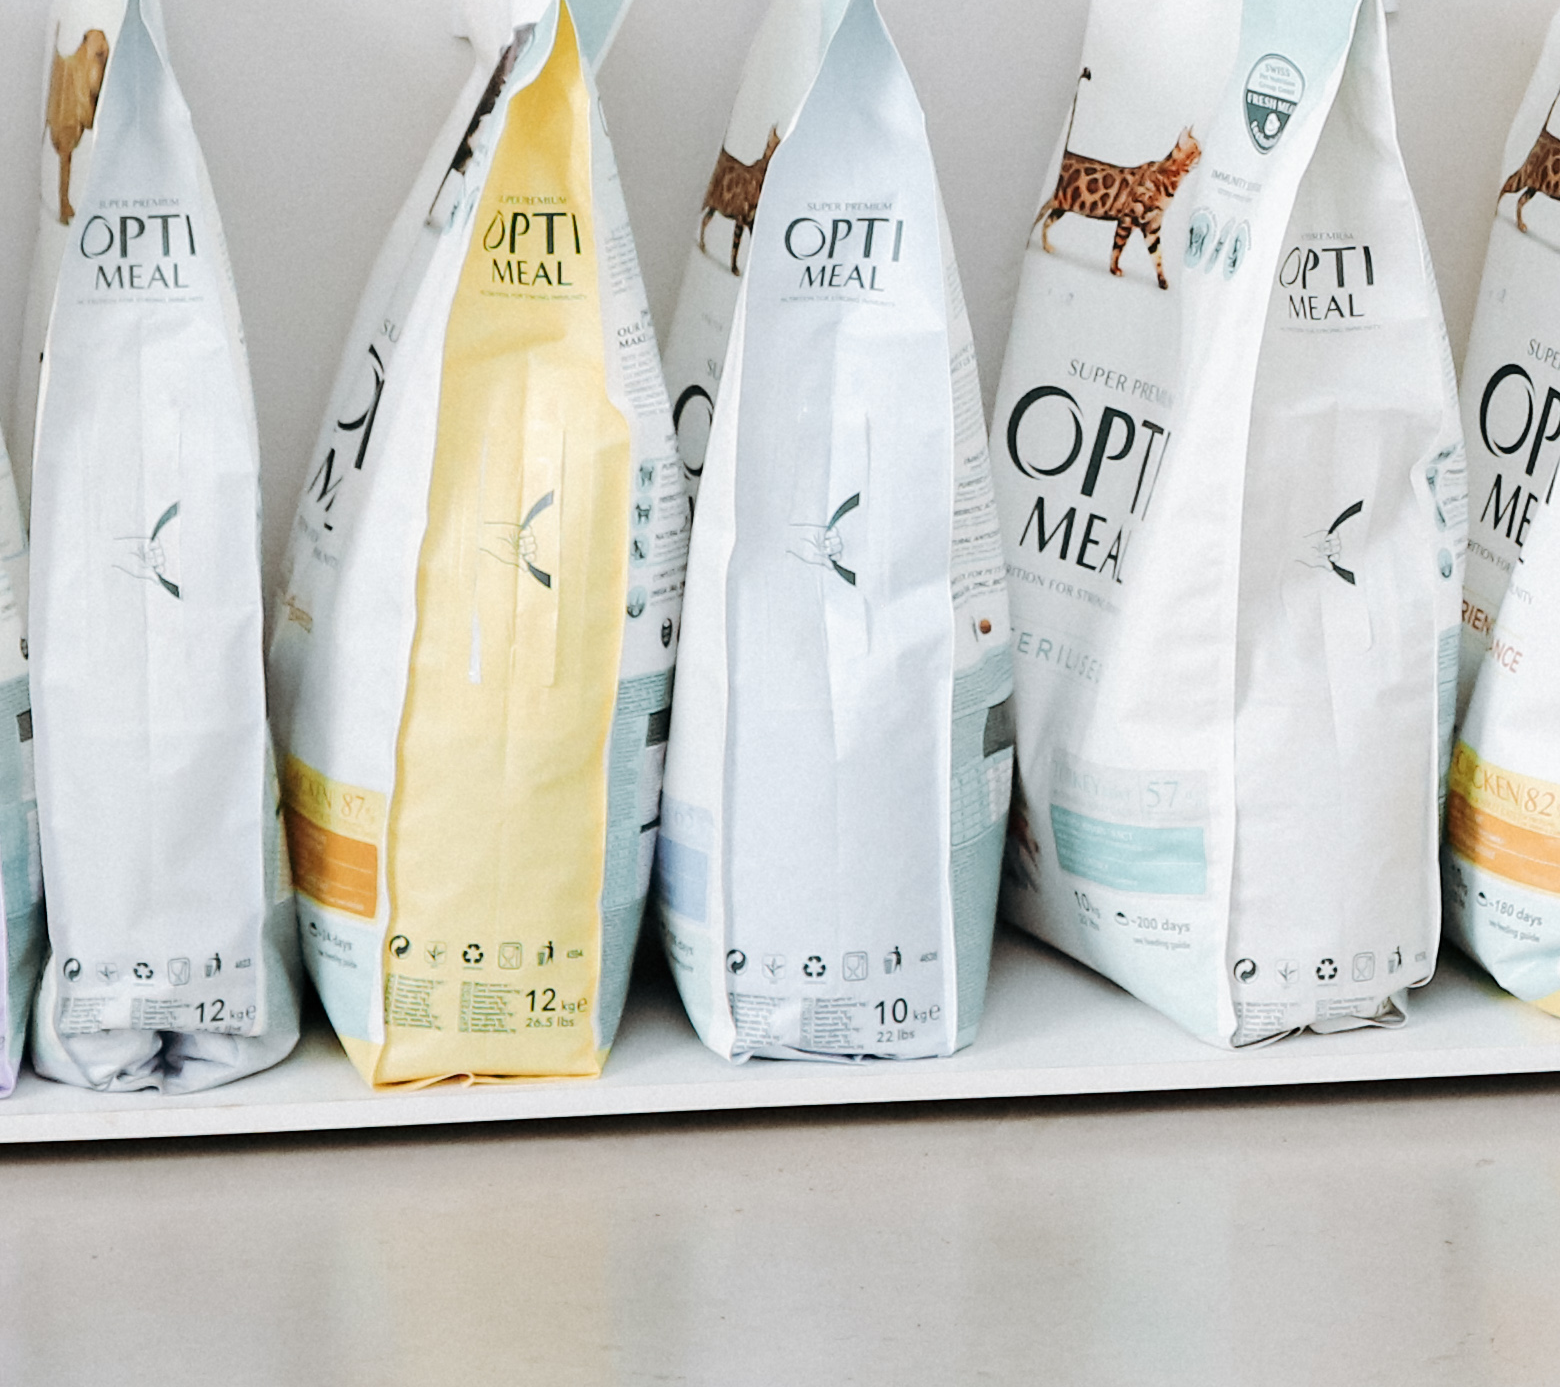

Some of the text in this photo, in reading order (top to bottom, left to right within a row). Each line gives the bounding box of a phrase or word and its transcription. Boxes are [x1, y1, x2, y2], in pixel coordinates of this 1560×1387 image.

[79, 213, 196, 259] OPTI
[483, 210, 581, 255] OPTI
[784, 217, 903, 261] OPTI
[95, 263, 191, 291] MEAL
[492, 258, 569, 286] MEAL
[799, 263, 886, 292] MEAL
[1279, 245, 1374, 290] OPTI
[1289, 293, 1364, 321] MEAL
[1068, 362, 1130, 392] SUPER
[1020, 497, 1124, 584] MEAL
[1162, 918, 1191, 933] days
[195, 1000, 225, 1023] 12
[525, 988, 556, 1012] 12
[874, 998, 908, 1025] 10
